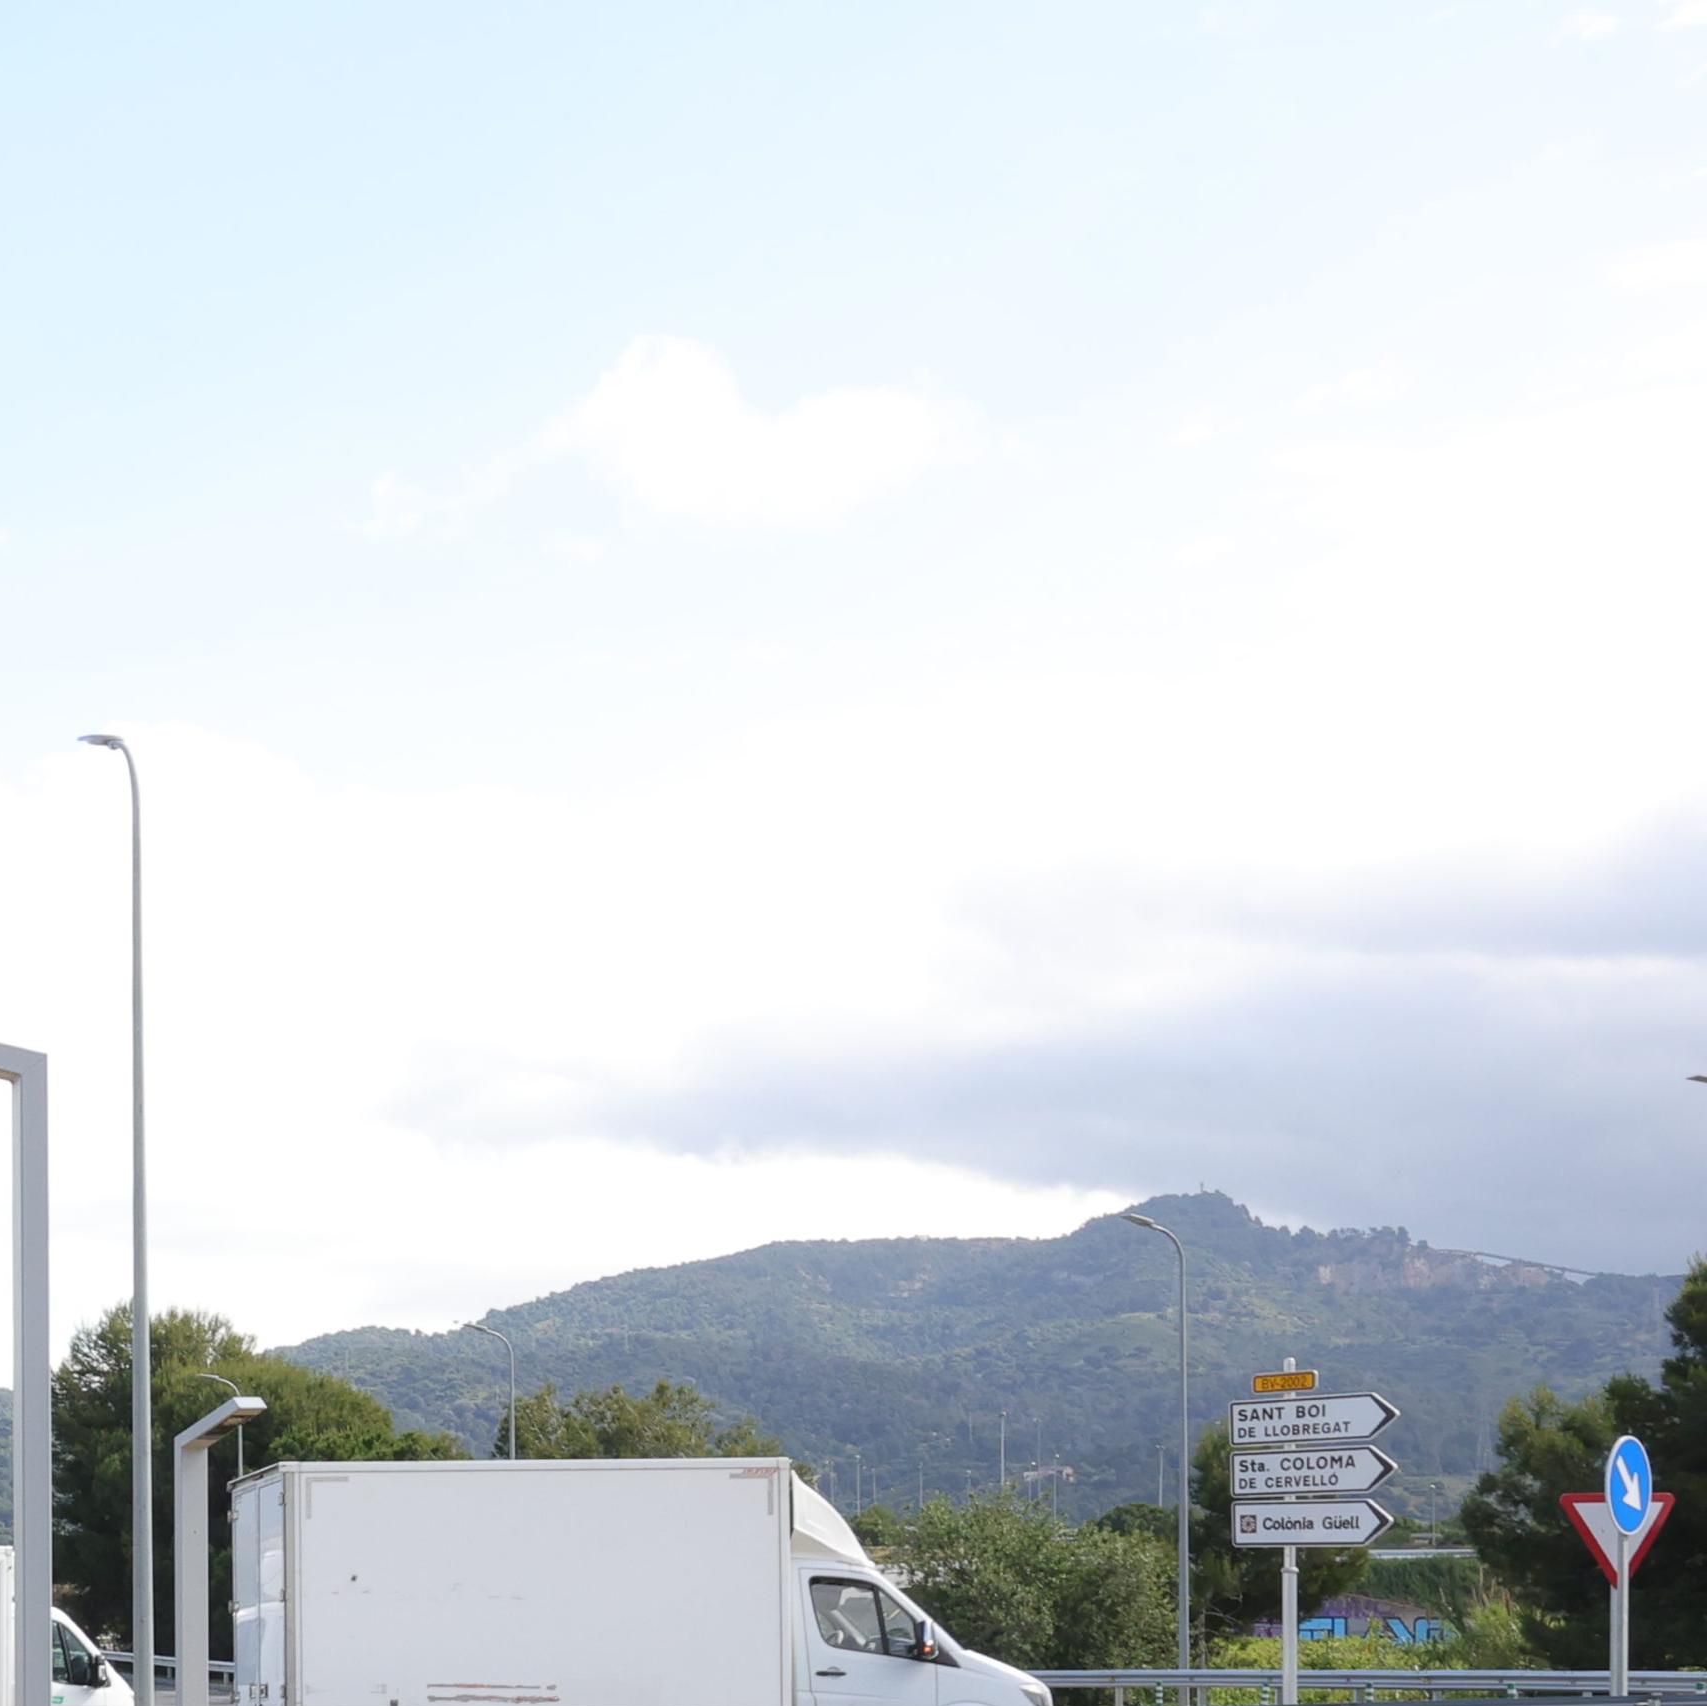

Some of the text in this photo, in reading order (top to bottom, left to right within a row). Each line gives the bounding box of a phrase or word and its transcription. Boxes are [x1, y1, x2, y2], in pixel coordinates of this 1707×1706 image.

[1261, 1376, 1307, 1389] BV-2002
[1238, 1404, 1327, 1422] SANT BOI
[1237, 1421, 1351, 1439] DE LLOBREGAT
[1239, 1455, 1356, 1473] Sta. COLOMA
[1238, 1472, 1339, 1490] DE CERVELLÓ
[1262, 1515, 1360, 1531] Colònia Güell
